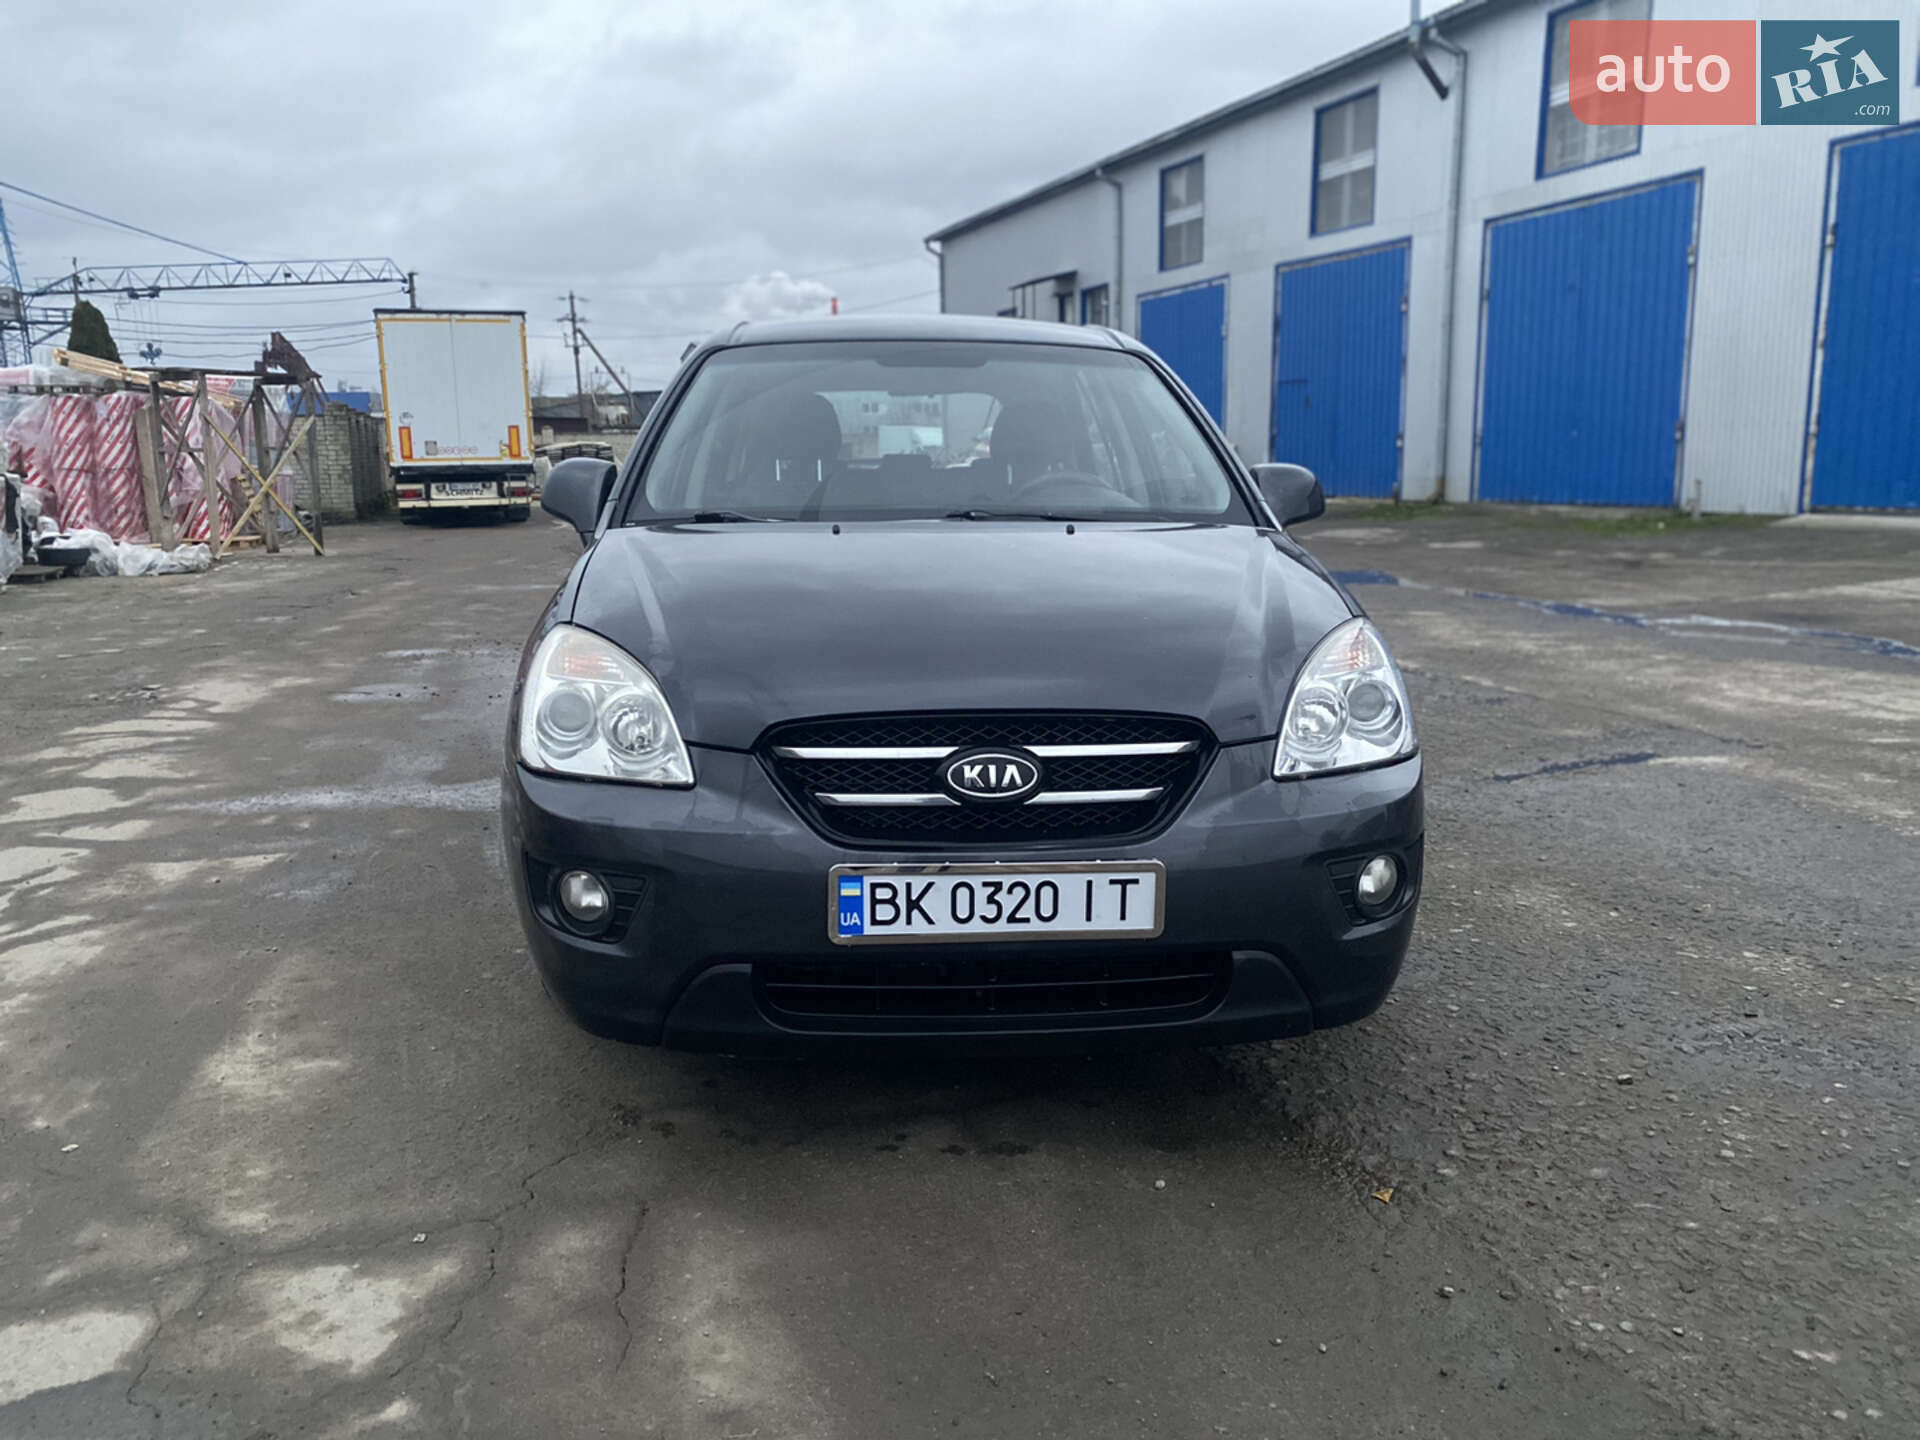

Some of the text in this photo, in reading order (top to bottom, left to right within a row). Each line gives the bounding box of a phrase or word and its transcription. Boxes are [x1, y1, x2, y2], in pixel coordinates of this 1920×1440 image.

[962, 764, 1023, 787] KIA
[869, 879, 1140, 926] BK 0320 IT
[840, 912, 861, 926] UA
